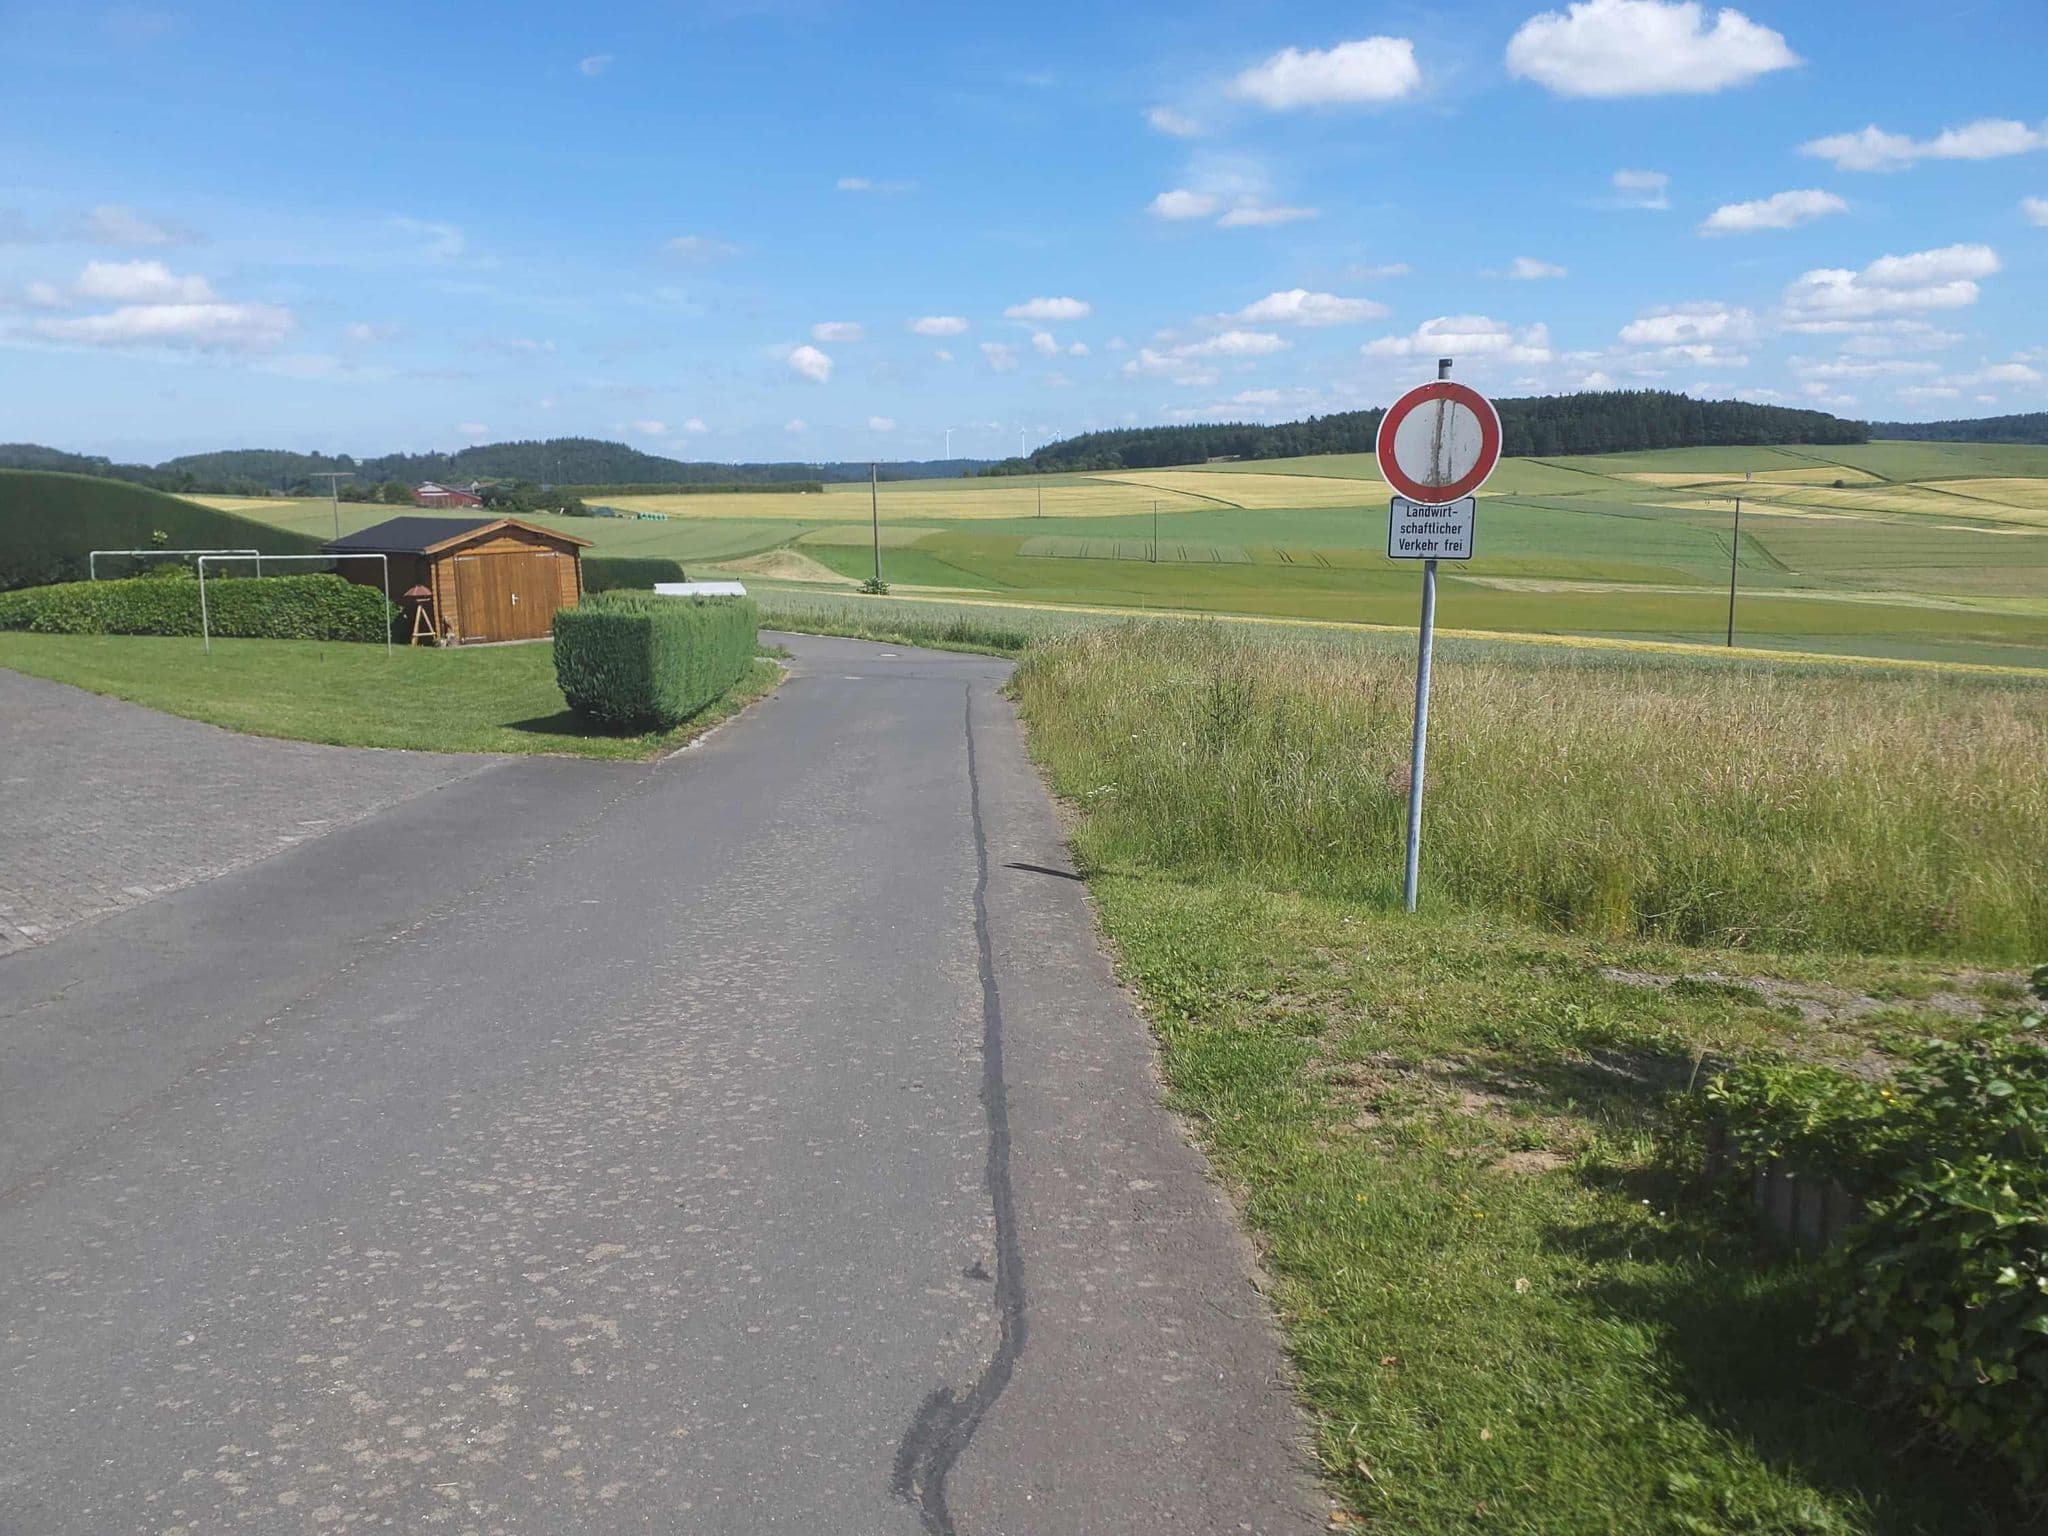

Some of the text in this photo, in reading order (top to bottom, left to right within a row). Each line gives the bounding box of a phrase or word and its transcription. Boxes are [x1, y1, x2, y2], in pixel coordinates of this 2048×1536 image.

[1406, 505, 1458, 517] Landwirt-
[1400, 522, 1463, 534] schaftlicher
[1399, 538, 1463, 551] Verkehr frei
